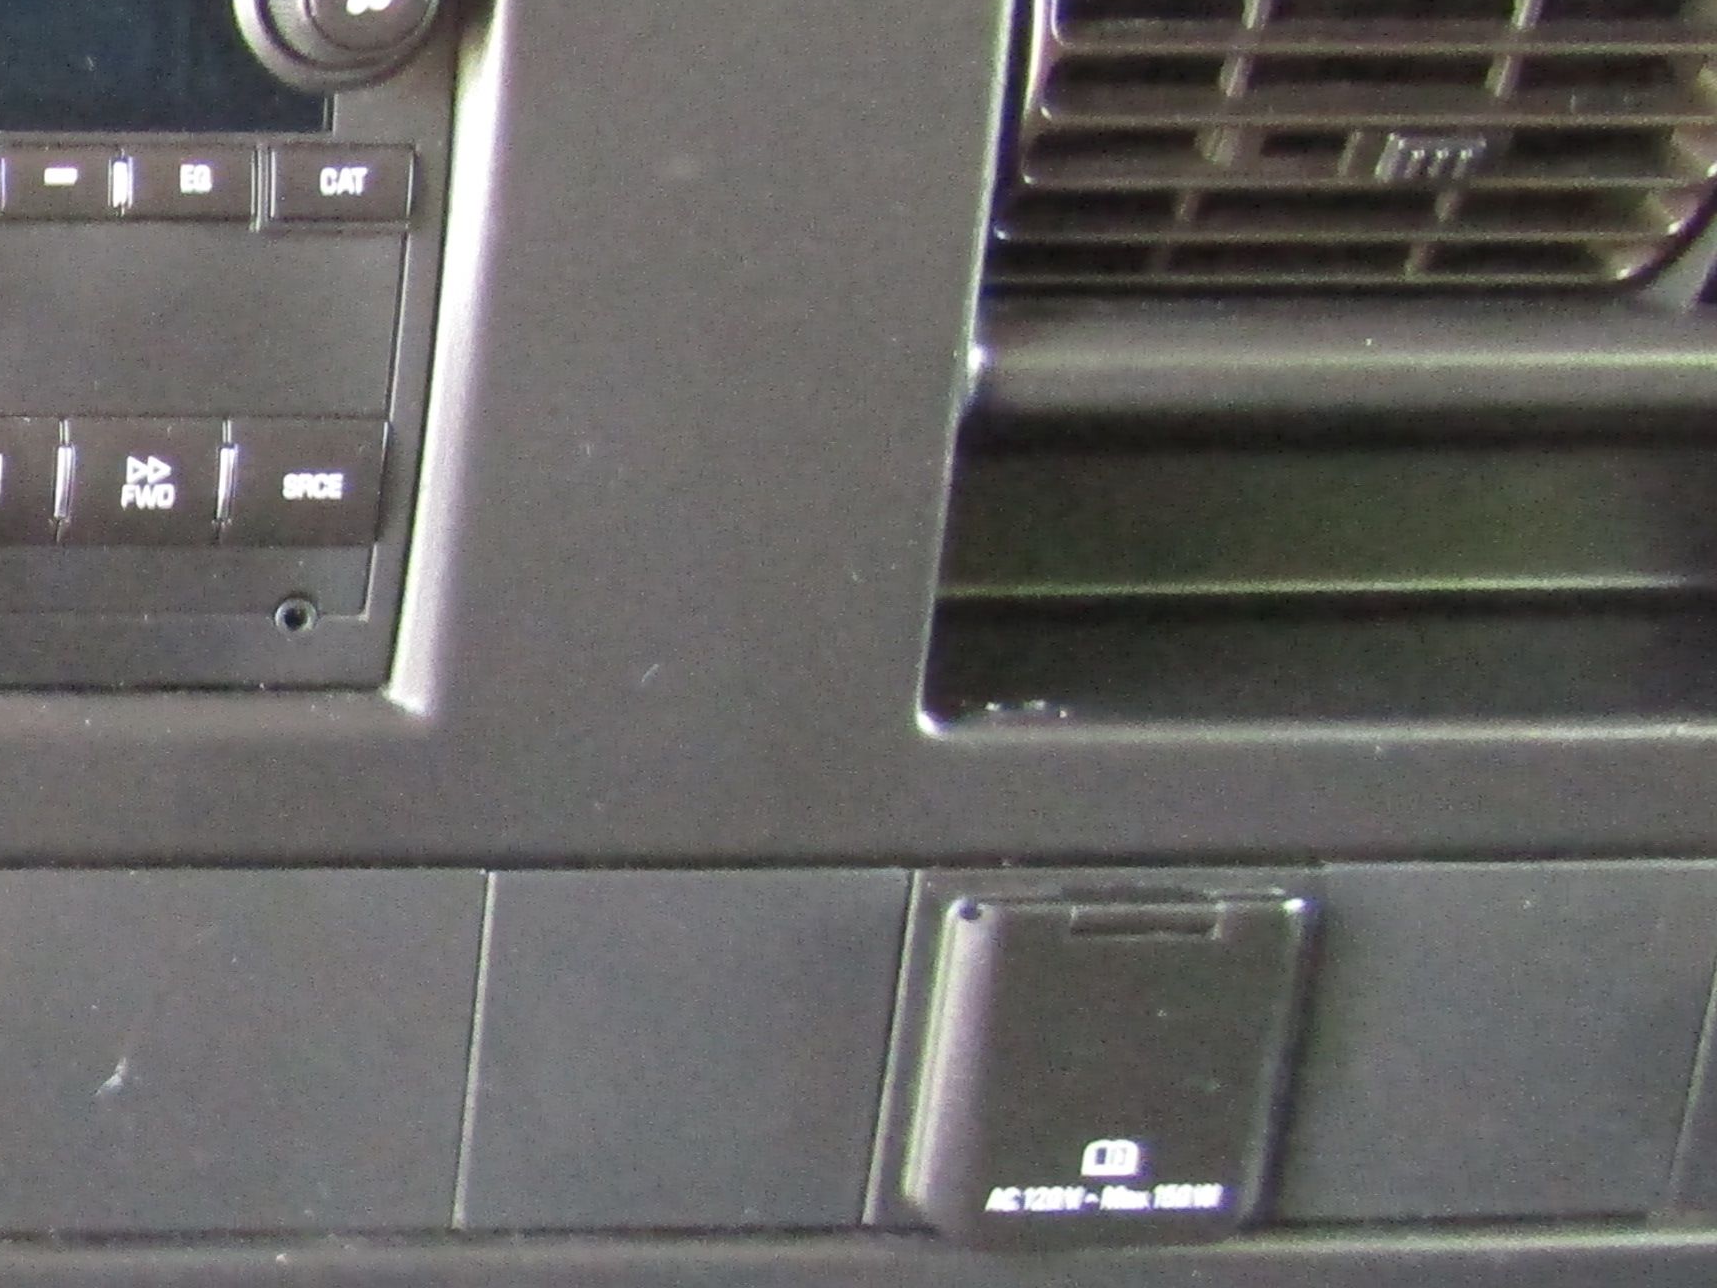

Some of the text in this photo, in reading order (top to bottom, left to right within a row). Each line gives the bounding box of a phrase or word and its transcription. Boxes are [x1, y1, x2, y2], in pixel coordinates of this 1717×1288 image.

[320, 167, 367, 194] CAT
[122, 484, 176, 509] FWD
[283, 473, 342, 500] SRCE
